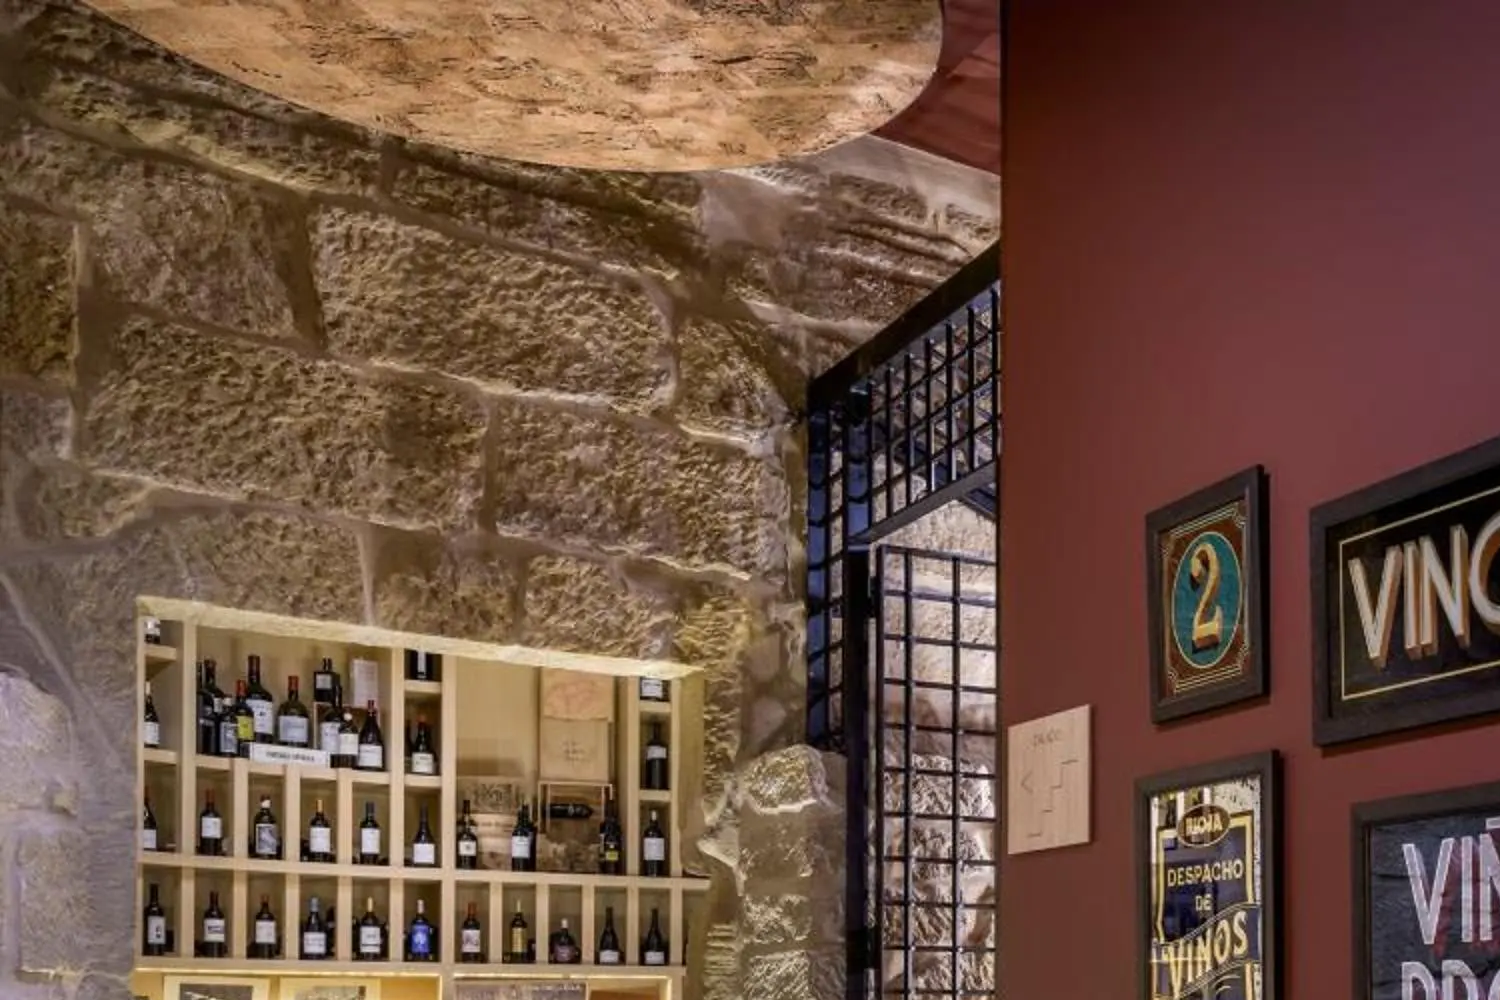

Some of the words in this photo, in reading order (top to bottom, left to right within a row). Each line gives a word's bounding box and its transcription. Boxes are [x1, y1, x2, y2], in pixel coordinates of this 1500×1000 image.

[1190, 542, 1223, 650] 2
[1167, 857, 1244, 887] DESPACHO
[1195, 895, 1212, 911] DE
[1164, 911, 1248, 1000] VINOS
